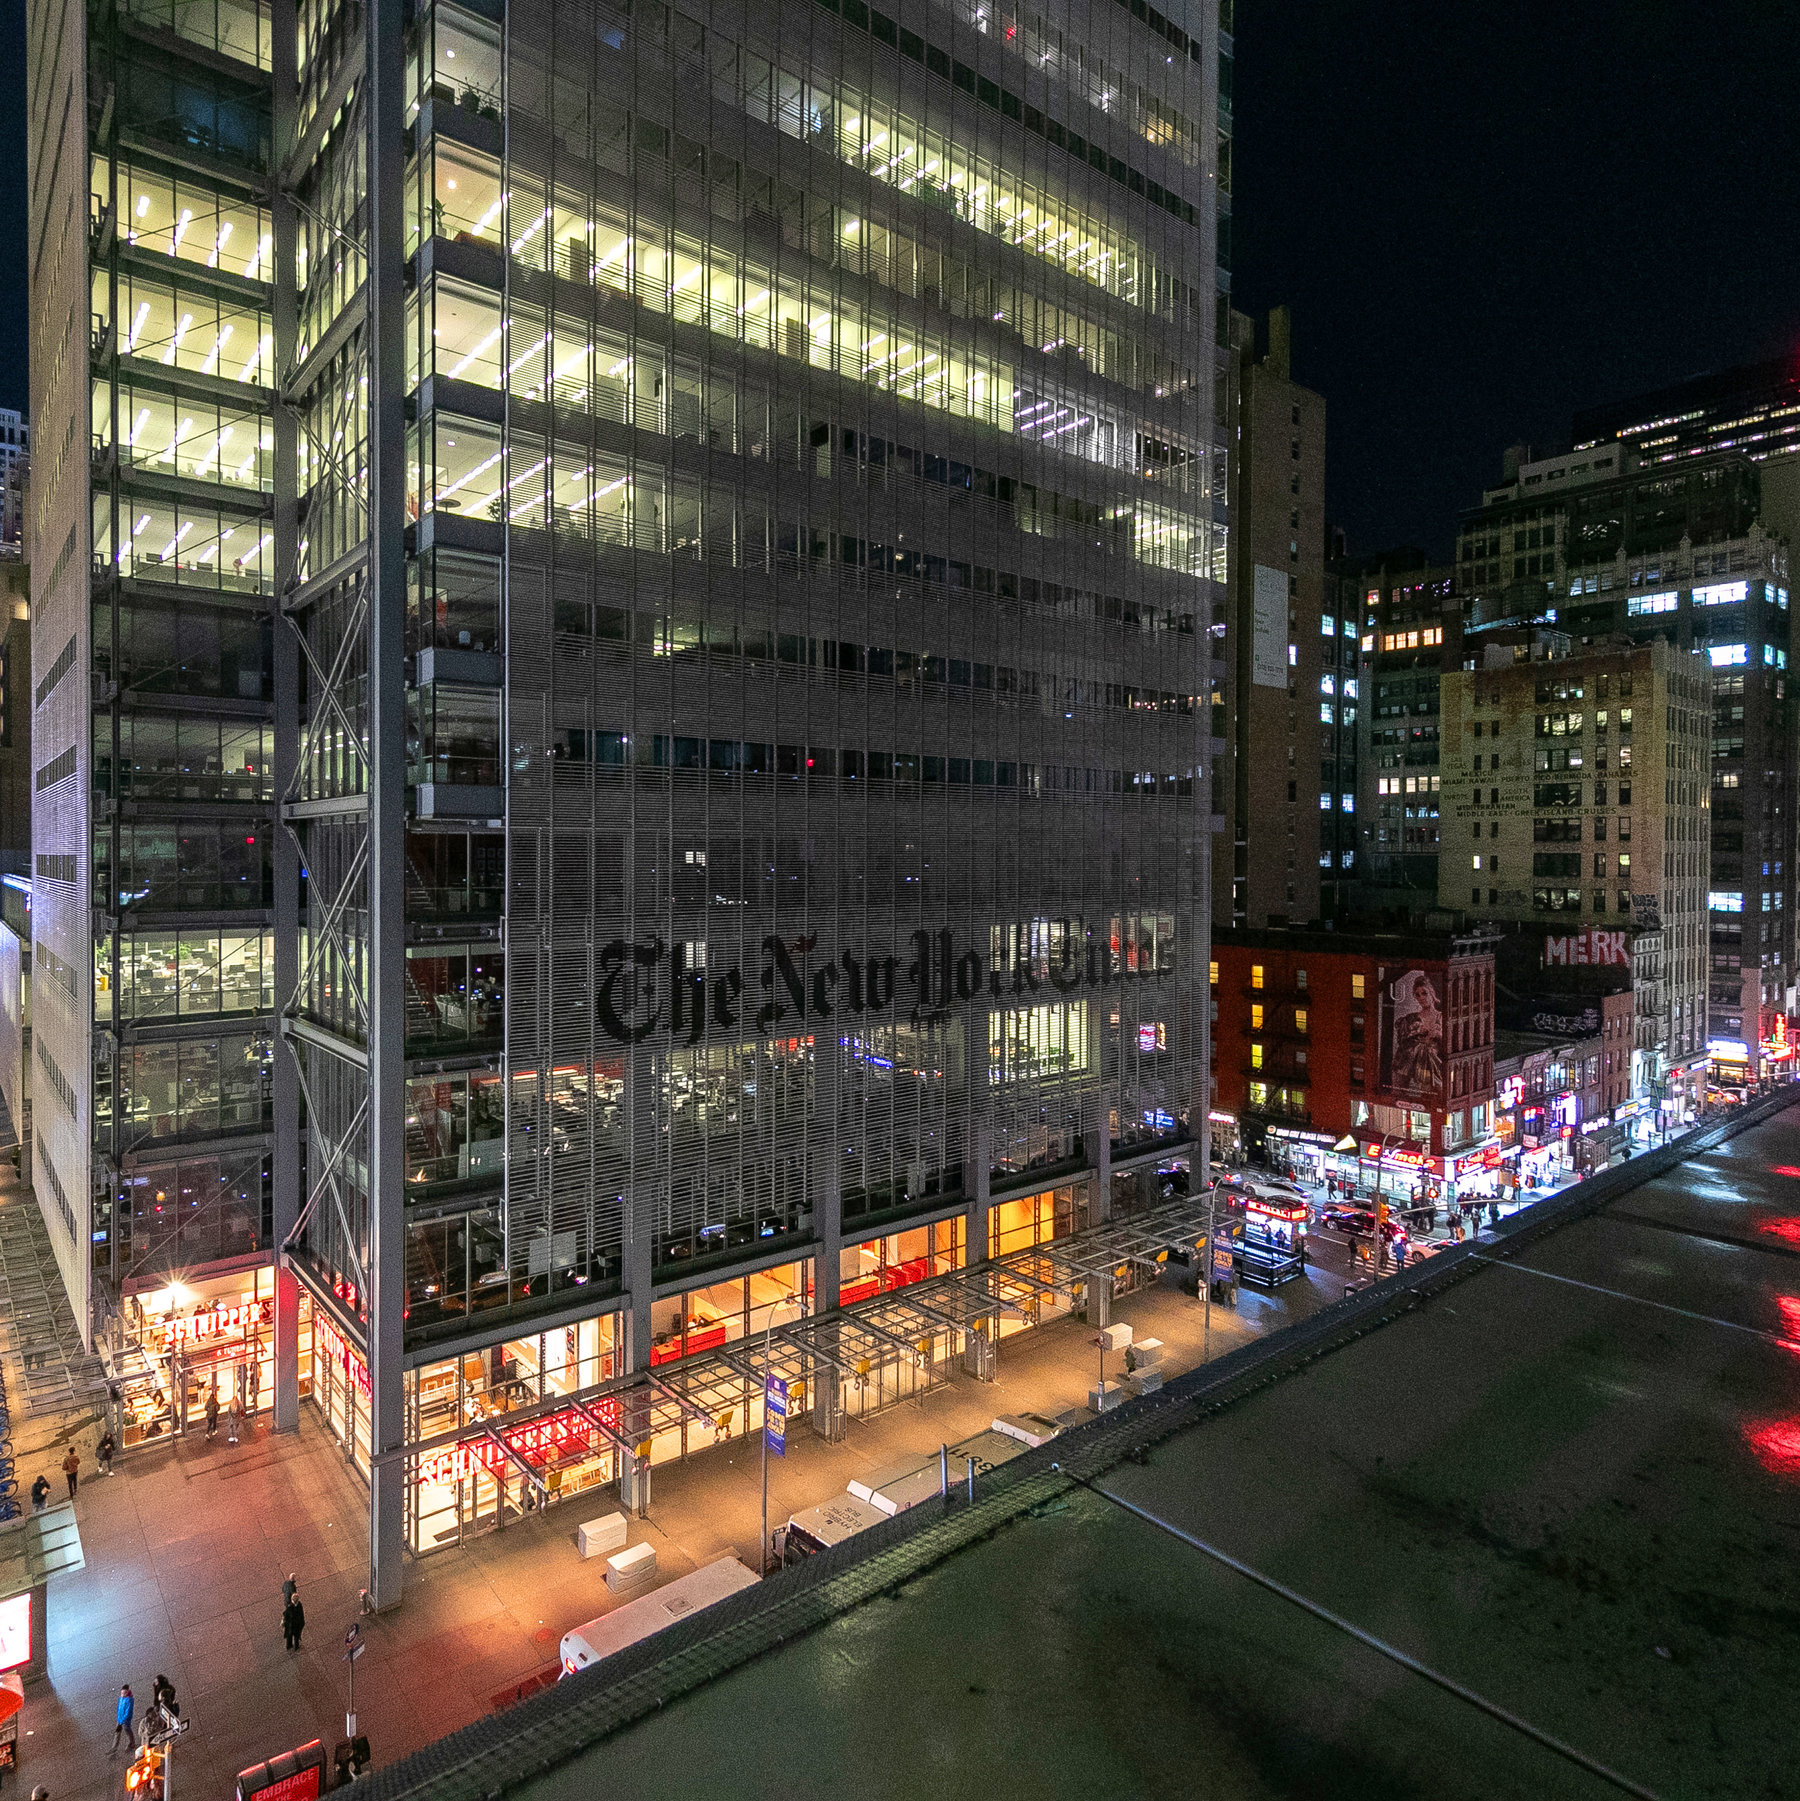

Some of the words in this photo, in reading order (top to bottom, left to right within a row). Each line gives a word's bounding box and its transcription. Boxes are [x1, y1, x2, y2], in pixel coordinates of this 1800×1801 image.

[1546, 930, 1630, 966] MERK
[597, 934, 743, 1048] The
[756, 930, 900, 1036] New
[844, 1506, 862, 1518] BUS
[256, 1769, 315, 1801] EMBRACE
